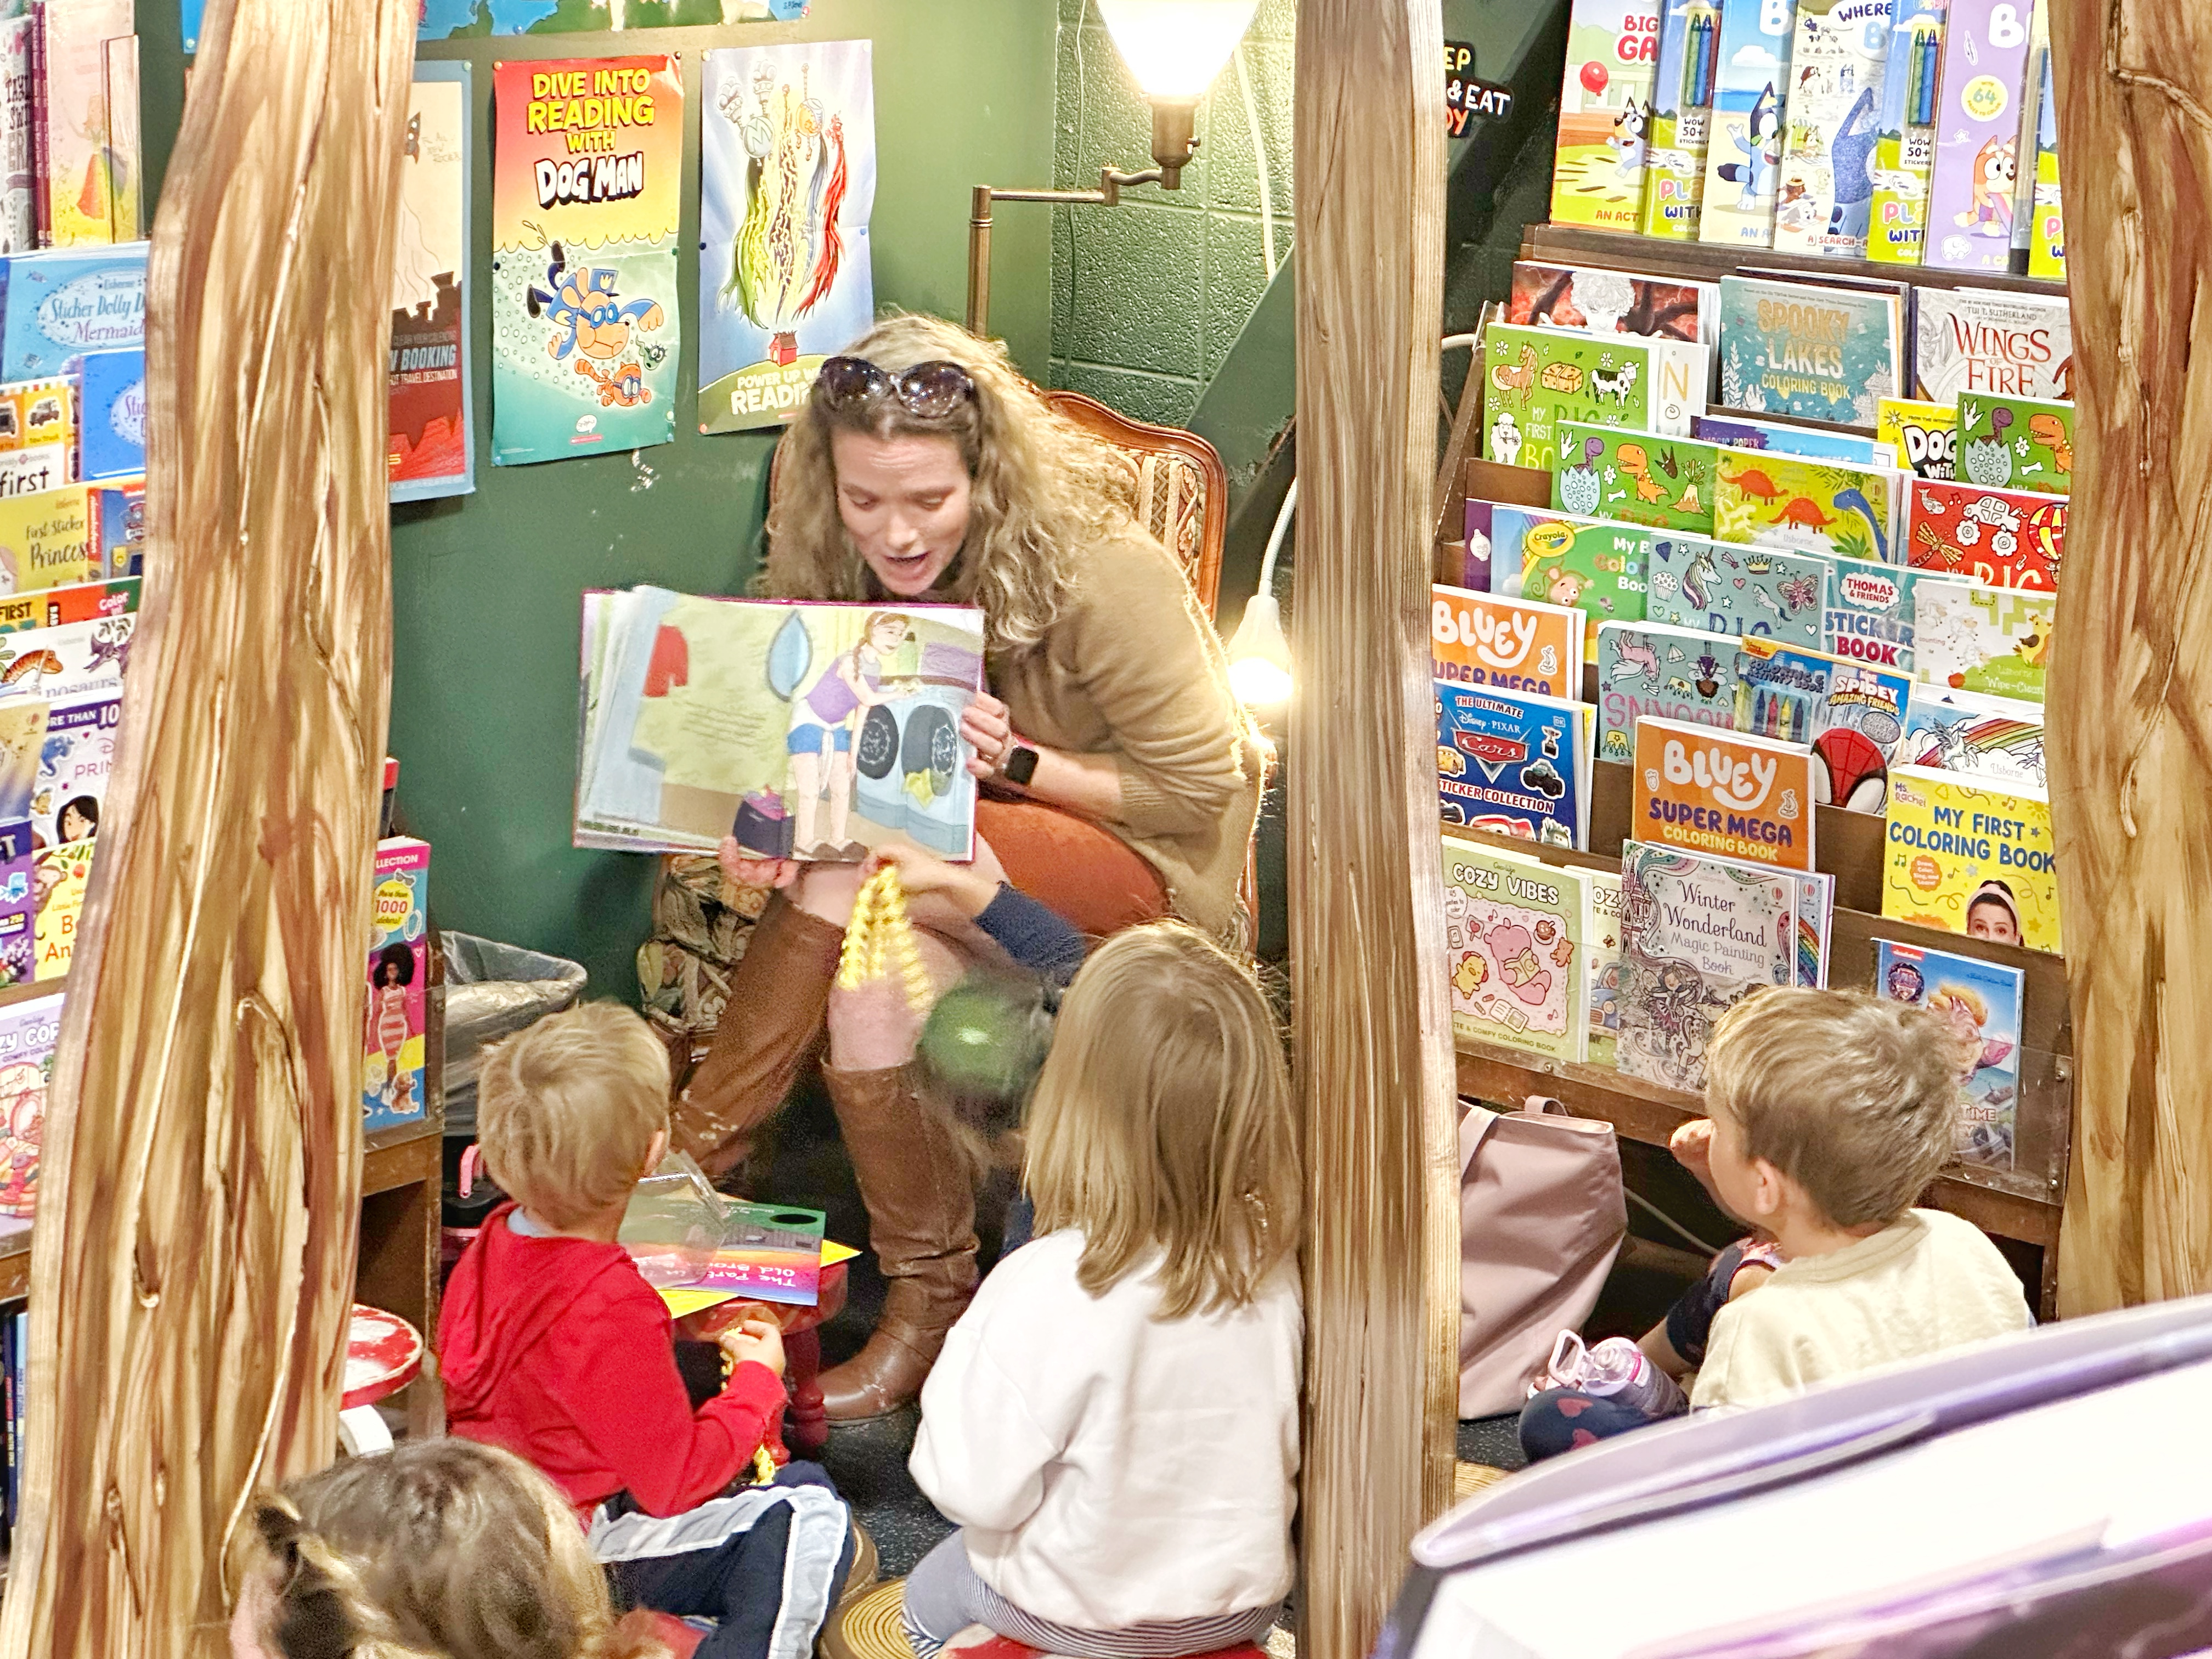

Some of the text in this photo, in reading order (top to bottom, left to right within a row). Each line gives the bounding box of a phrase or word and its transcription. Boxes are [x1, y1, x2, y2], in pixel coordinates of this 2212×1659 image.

[1624, 15, 1658, 32] BIG
[1618, 35, 1657, 61] GA
[533, 68, 650, 100] DIVE INTO
[1973, 87, 1997, 104] 64
[1465, 84, 1511, 116] EAT
[527, 94, 655, 134] READING
[566, 129, 616, 155] WITH
[1683, 127, 1704, 136] 50+
[1908, 147, 1929, 157] 50+
[534, 151, 644, 210] DOG MAN
[1596, 210, 1611, 220] AN
[52, 297, 94, 322] Sticker
[97, 295, 131, 320] Dolly
[1758, 298, 1850, 343] SPOOKY
[1989, 309, 2037, 320] SUTHERLAND
[1947, 312, 2051, 364] WINGS
[400, 344, 456, 371] BOOKING
[1768, 337, 1844, 379] LAKES
[1989, 358, 2002, 366] OF
[423, 369, 457, 383] DESTINATION
[737, 372, 780, 389] POWER
[783, 369, 800, 383] UP
[1762, 374, 1852, 399] COLORING BOOK
[1966, 358, 2036, 397] FIRE
[1533, 407, 1545, 421] MY
[1526, 423, 1552, 440] FIRST
[1902, 425, 1957, 464] DOG
[1534, 531, 1566, 541] Crayola
[1614, 537, 1635, 554] My
[1847, 578, 1894, 596] THOMAS
[1857, 591, 1889, 604] FRIENDS
[1432, 601, 1537, 668] BLUEY
[1837, 636, 1899, 667] BOOK
[1491, 672, 1551, 696] MEGA
[1835, 675, 1899, 704] SPIDEY
[1985, 676, 2044, 695] Wipe-Clean
[1455, 696, 1523, 718] THE ULTIMATE
[1829, 693, 1900, 716] AMAZING FRIENDS
[68, 710, 97, 724] THAN
[1457, 710, 1521, 734] Disney PIXAR
[1554, 716, 1566, 727] DK
[1462, 736, 1519, 759] Cars
[1664, 740, 1777, 811] BLUEY
[1990, 763, 2023, 778] Usborne
[1483, 789, 1555, 815] COLLECTION
[1895, 793, 1927, 808] Rachel
[1650, 797, 1792, 848] SUPER MEGA
[1934, 806, 2025, 841] MY FIRST
[1663, 826, 1778, 862] COLORING BOOK
[1890, 822, 2056, 874] COLORING BOOK
[1453, 862, 1559, 905] COZY VIBES
[376, 900, 408, 913] 1000
[1678, 879, 1736, 913] Winter
[1663, 902, 1767, 947] Wonderland
[1671, 932, 1765, 968] Magic Painting
[1703, 957, 1734, 975] Book
[1473, 1027, 1496, 1037] COMFY
[1498, 1033, 1534, 1047] COLORING
[1536, 1042, 1556, 1052] BOOK
[1961, 1103, 1996, 1122] TIME
[758, 1266, 795, 1277] Old
[758, 1274, 795, 1288] The
